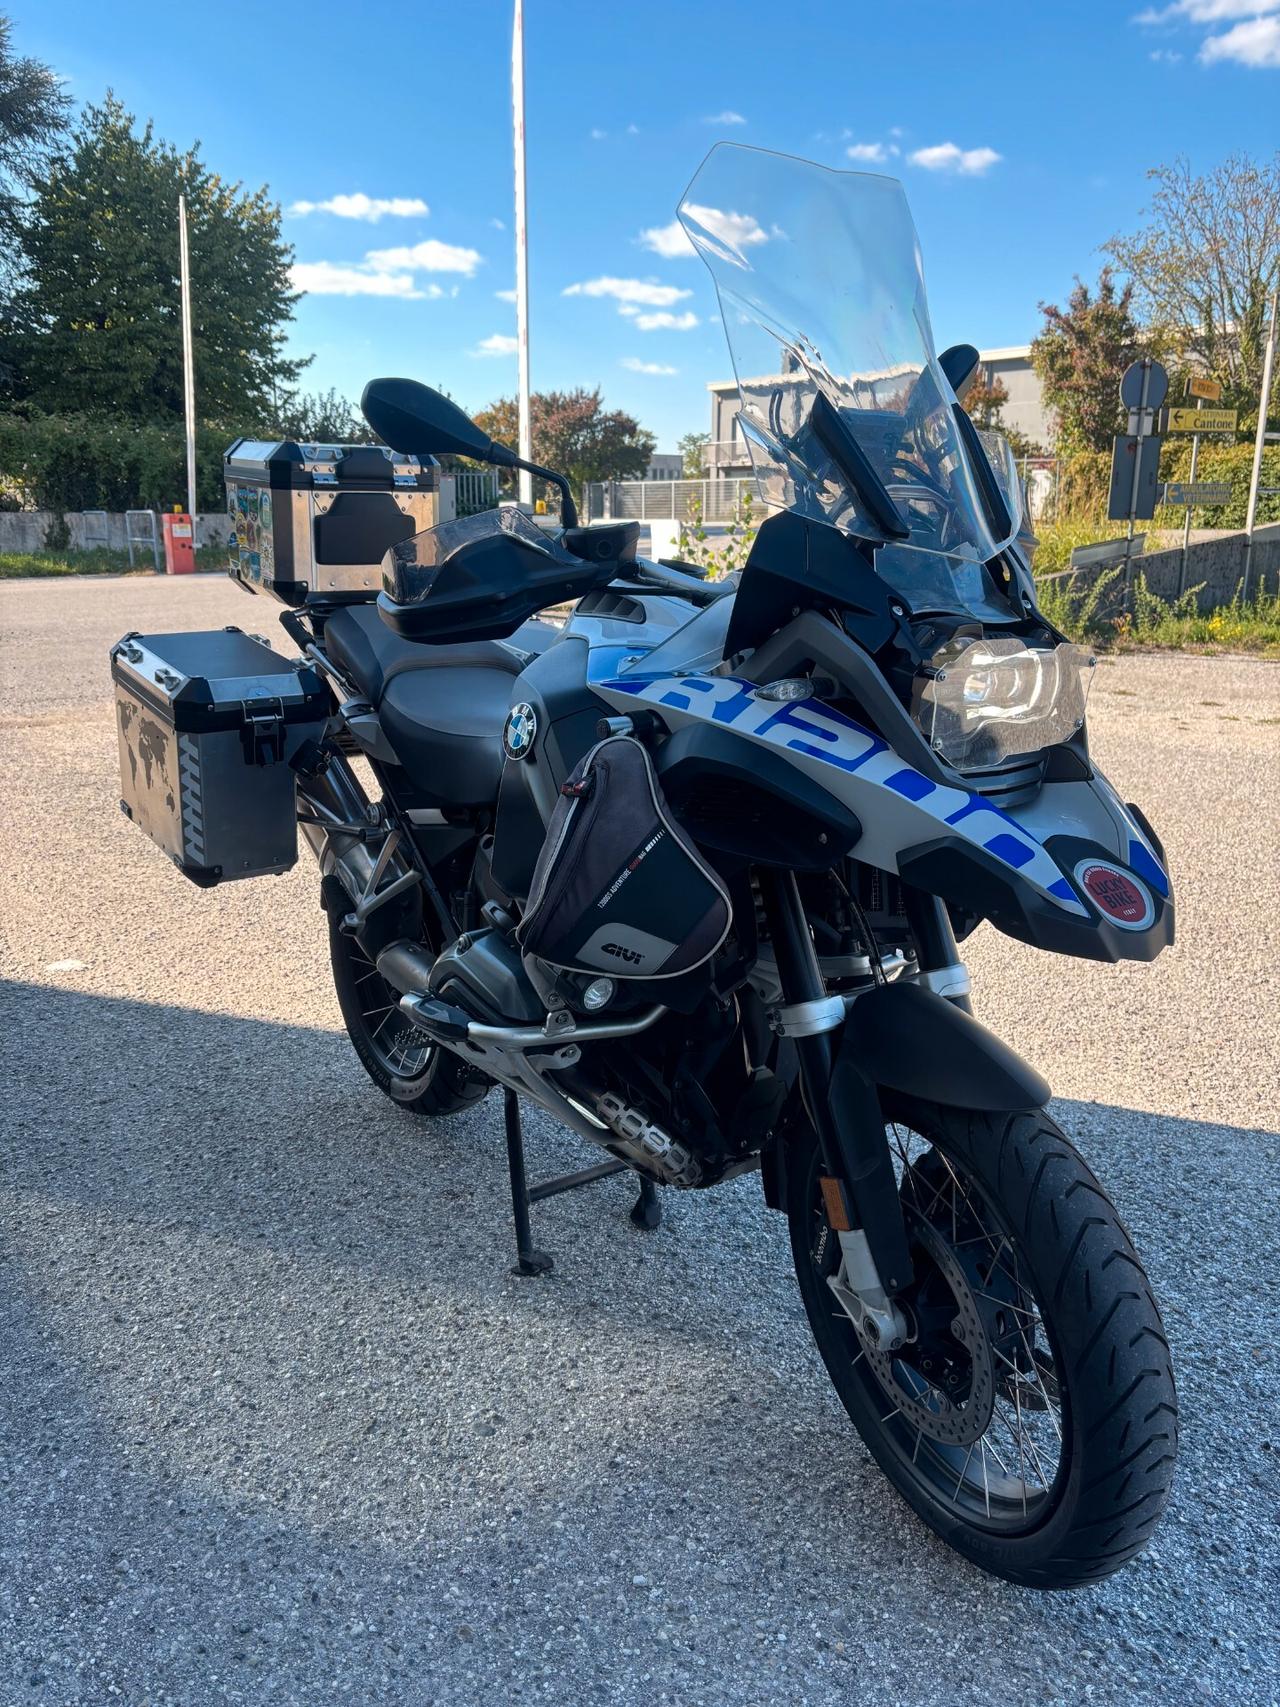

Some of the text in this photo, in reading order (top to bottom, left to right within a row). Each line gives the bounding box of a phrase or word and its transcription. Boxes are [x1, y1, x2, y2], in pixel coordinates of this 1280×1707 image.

[1193, 418, 1233, 429] Cantone
[610, 868, 631, 893] ADVENTURE
[1089, 878, 1127, 896] LUCKY
[1103, 889, 1138, 909] BIKE
[601, 943, 645, 965] GIVI
[815, 1225, 828, 1264] brembo
